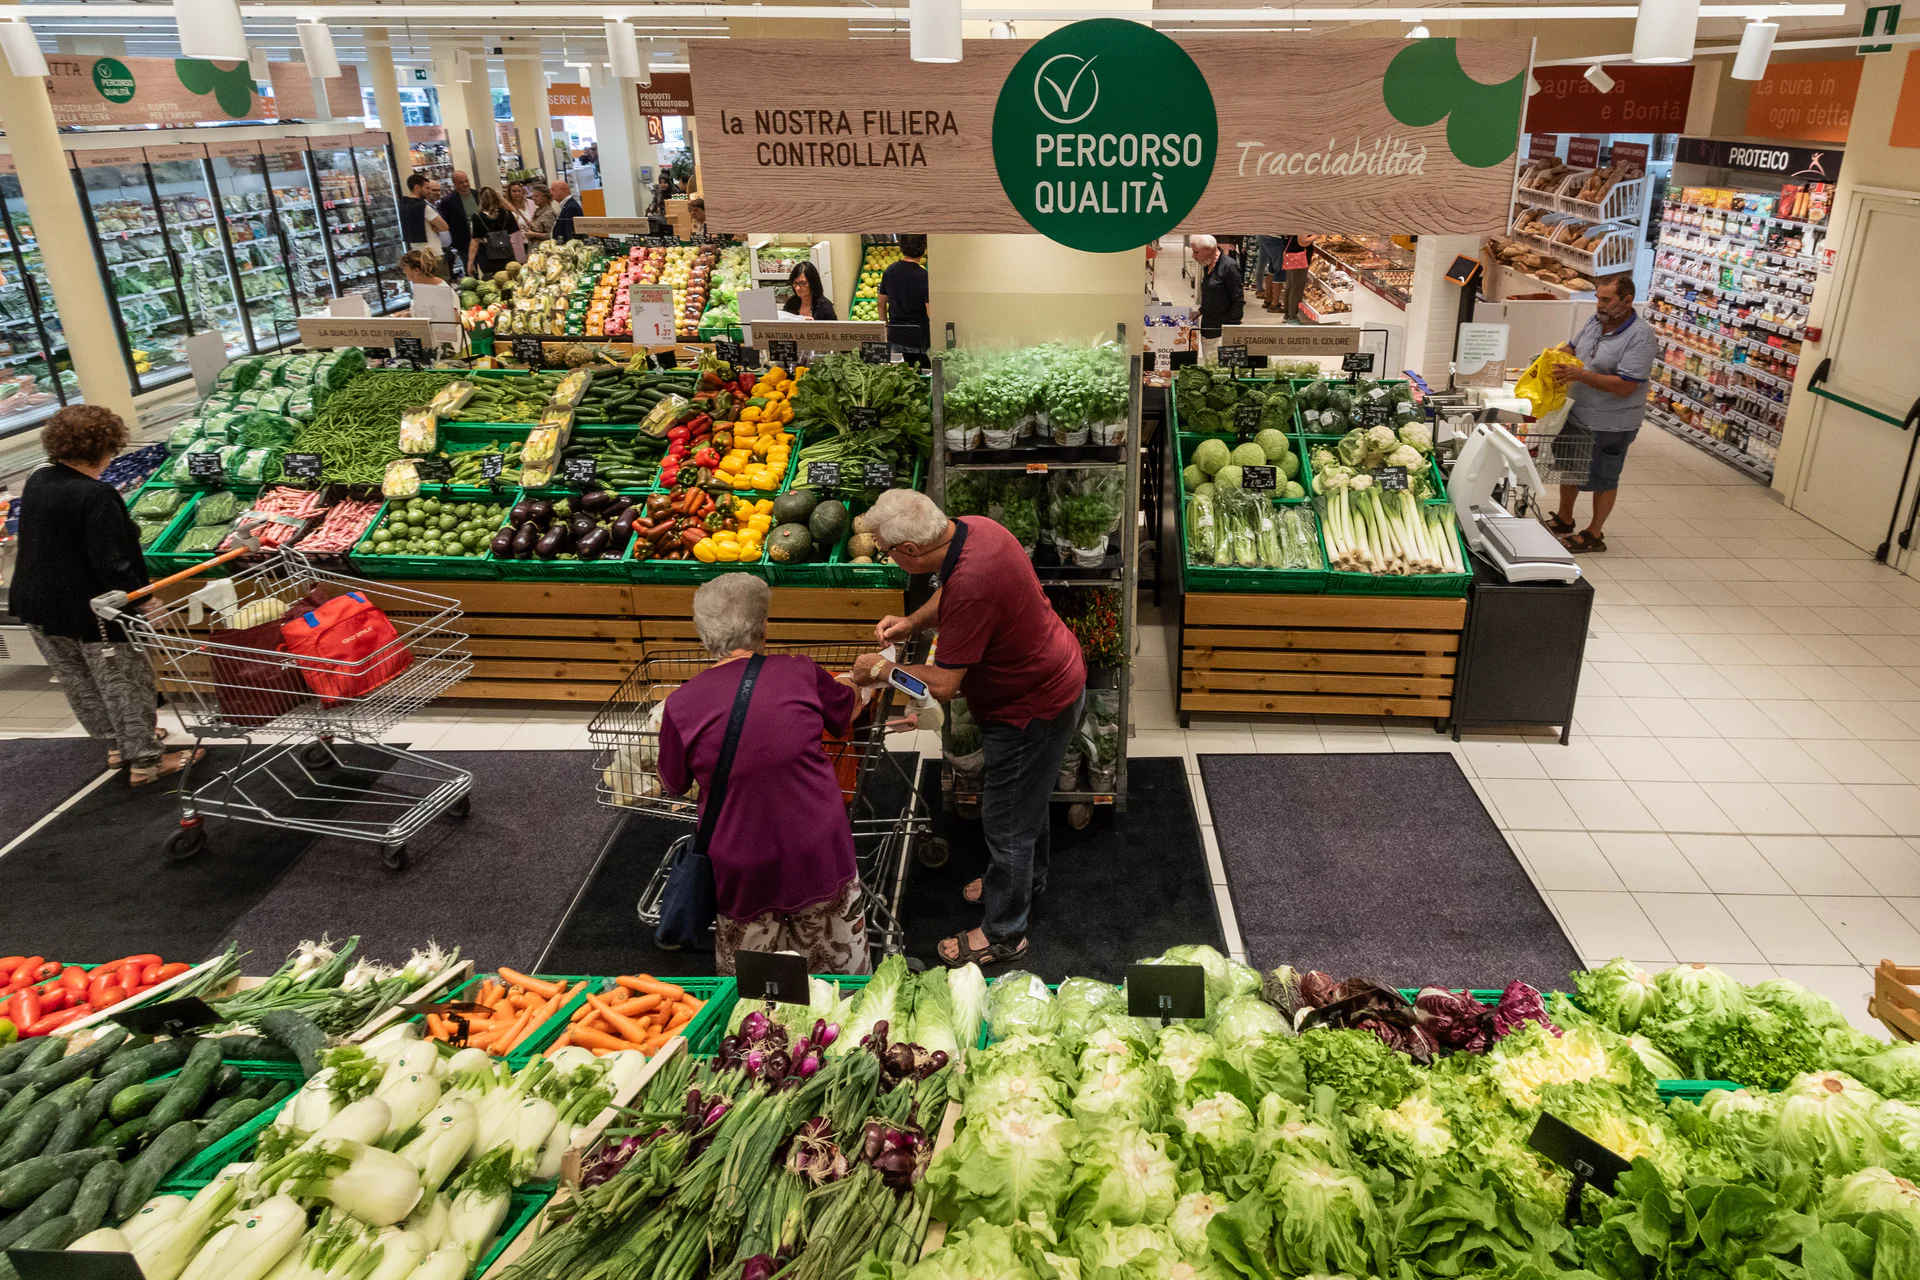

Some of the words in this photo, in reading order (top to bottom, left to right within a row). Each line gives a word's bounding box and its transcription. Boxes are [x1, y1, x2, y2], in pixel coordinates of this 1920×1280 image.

[101, 78, 134, 88] PERCORSO
[1779, 78, 1813, 96] cura
[1819, 73, 1836, 96] in
[103, 85, 132, 97] QUALITÀ
[640, 92, 671, 100] PRODOTTI
[547, 94, 578, 105] SERVE
[653, 100, 690, 108] TERRITORIO
[147, 102, 180, 112] RISPETTO
[1601, 107, 1613, 121] e
[1621, 100, 1681, 121] Bontà
[80, 112, 111, 122] FILIERA
[150, 111, 162, 120] PER
[1768, 103, 1801, 130] ogni
[720, 109, 745, 135] la
[754, 109, 853, 136] NOSTRA
[863, 109, 960, 136] FILIERA
[756, 141, 928, 168] CONTROLLATA
[1035, 132, 1203, 168] PERCORSO
[1235, 132, 1429, 177] Tracciabilità
[1728, 147, 1790, 171] PROTEICO
[1034, 171, 1169, 214] QUALITÀ
[318, 329, 328, 337] LA
[330, 327, 359, 338] QUALITÀ
[361, 329, 369, 337] DI
[370, 329, 382, 337] CUI
[383, 330, 412, 338] FIDARSI
[753, 331, 764, 340] LA
[765, 331, 793, 341] NATURA
[795, 331, 805, 341] LA
[806, 331, 830, 342] BONTÀ
[831, 332, 839, 341] IL
[840, 332, 882, 342] BENESSERE
[1232, 336, 1243, 345] LE
[1244, 336, 1277, 346] STAGIONI
[1278, 336, 1286, 346] IL
[1287, 336, 1312, 346] GUSTO
[1312, 336, 1320, 346] IL
[1321, 337, 1350, 347] COLORE
